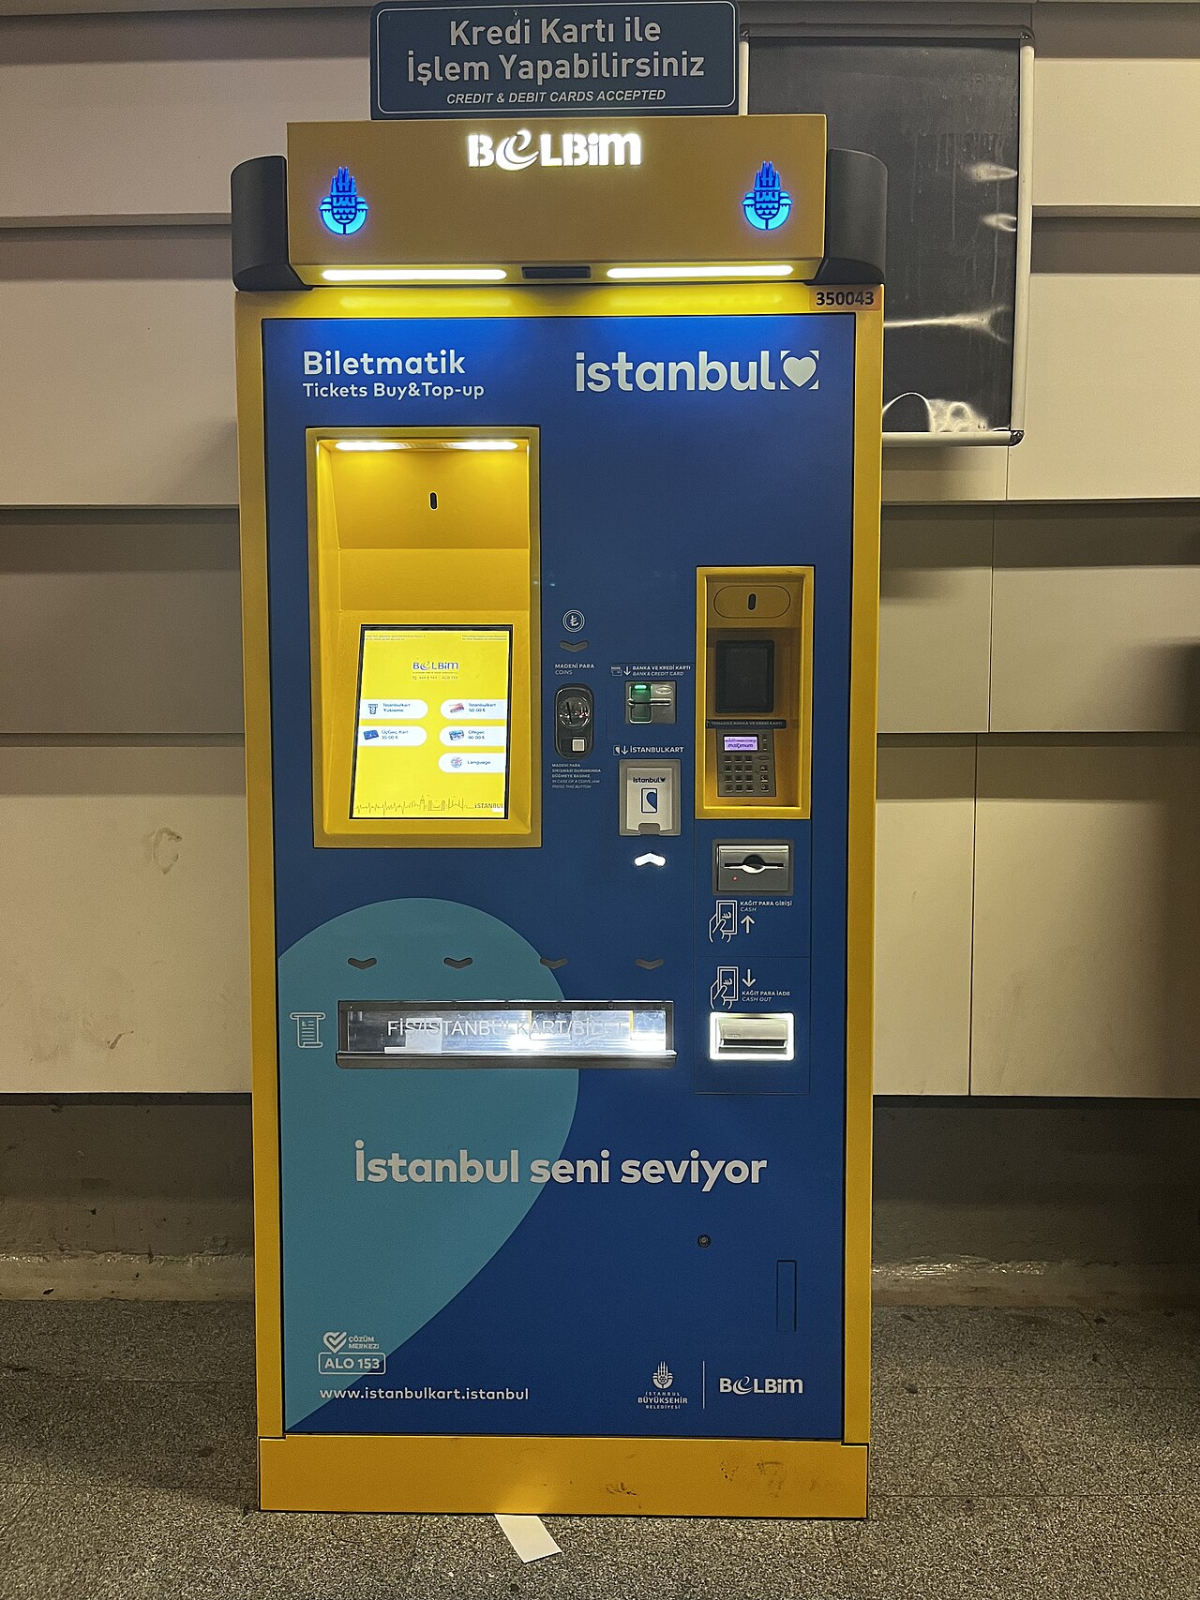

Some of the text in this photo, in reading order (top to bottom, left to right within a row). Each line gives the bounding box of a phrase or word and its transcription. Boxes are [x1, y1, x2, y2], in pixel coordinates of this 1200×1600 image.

[450, 17, 661, 46] Kredi Kartı ile
[407, 51, 705, 86] İşlem Yapabilirsiniz
[446, 89, 666, 105] CREDIT & DEBIT CARDS ACCEPTED
[816, 291, 875, 307] 350043
[303, 350, 465, 377] Biletmatik
[575, 350, 775, 393] istanbul
[303, 383, 485, 401] Tickets Buy&Top-up
[630, 745, 684, 754] İSTANBULKART
[355, 1139, 768, 1192] İstanbul seni seviyor
[324, 1358, 380, 1369] ALO 153
[319, 1386, 529, 1400] www.istanbulkart.istanbul
